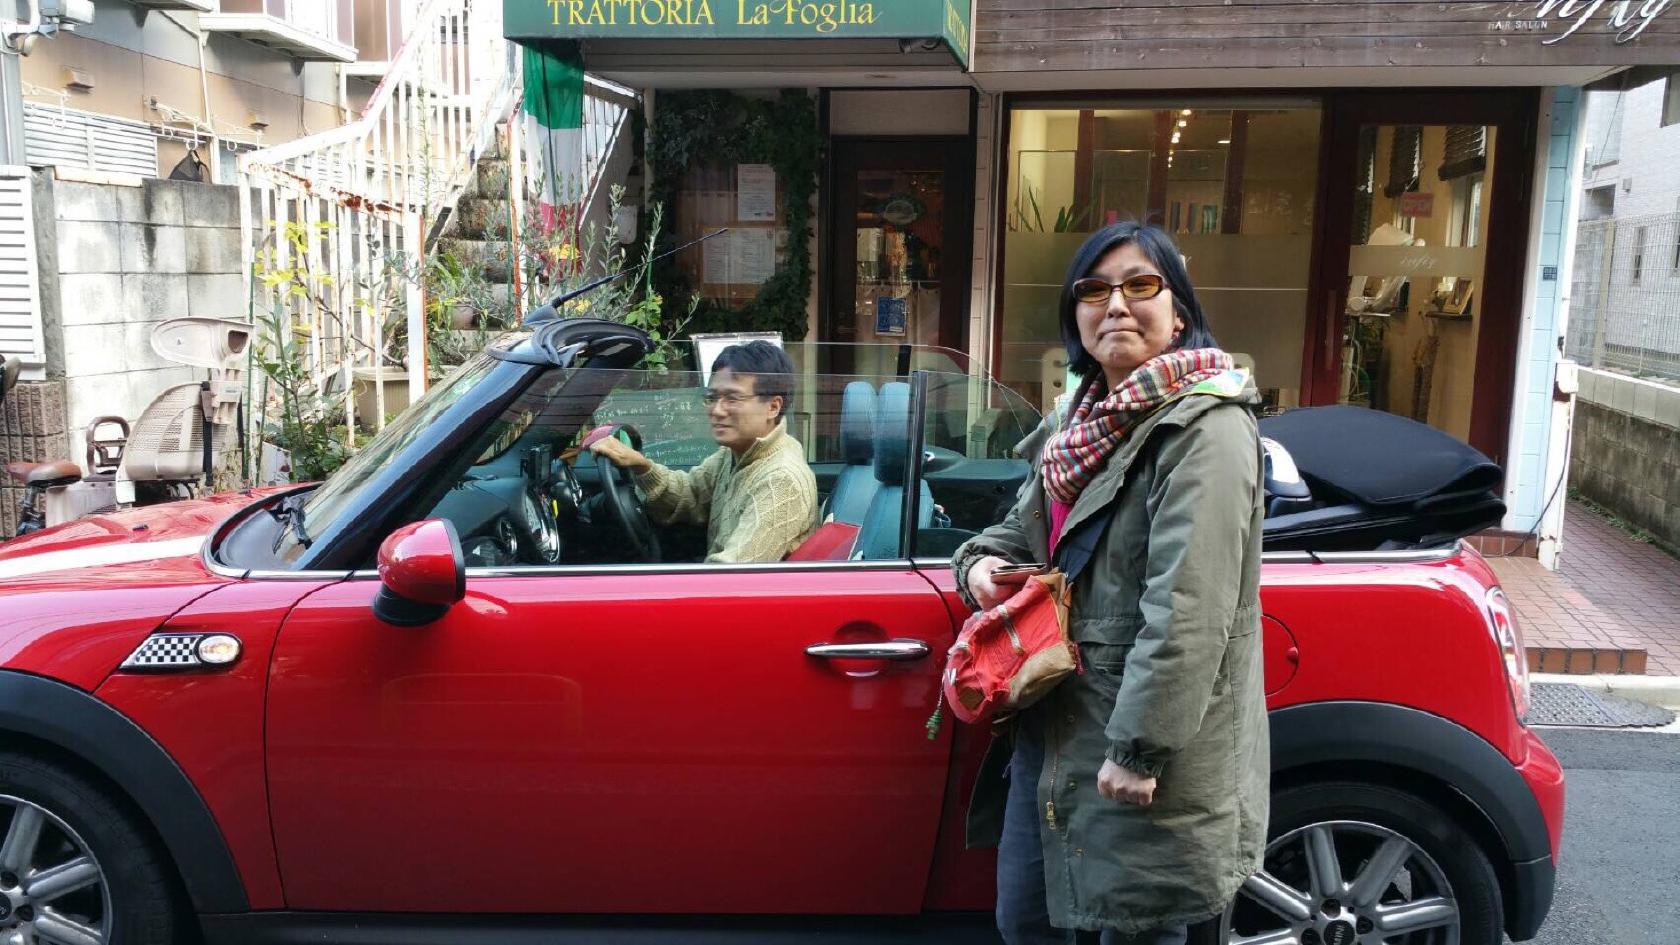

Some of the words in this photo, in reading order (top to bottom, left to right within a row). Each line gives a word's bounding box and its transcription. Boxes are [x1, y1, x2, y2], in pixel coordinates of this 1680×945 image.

[547, 0, 715, 25] TRATTORIA
[736, 0, 770, 25] La
[769, 0, 882, 33] Foglia
[1488, 20, 1511, 30] HAIR
[1515, 20, 1548, 29] SALON
